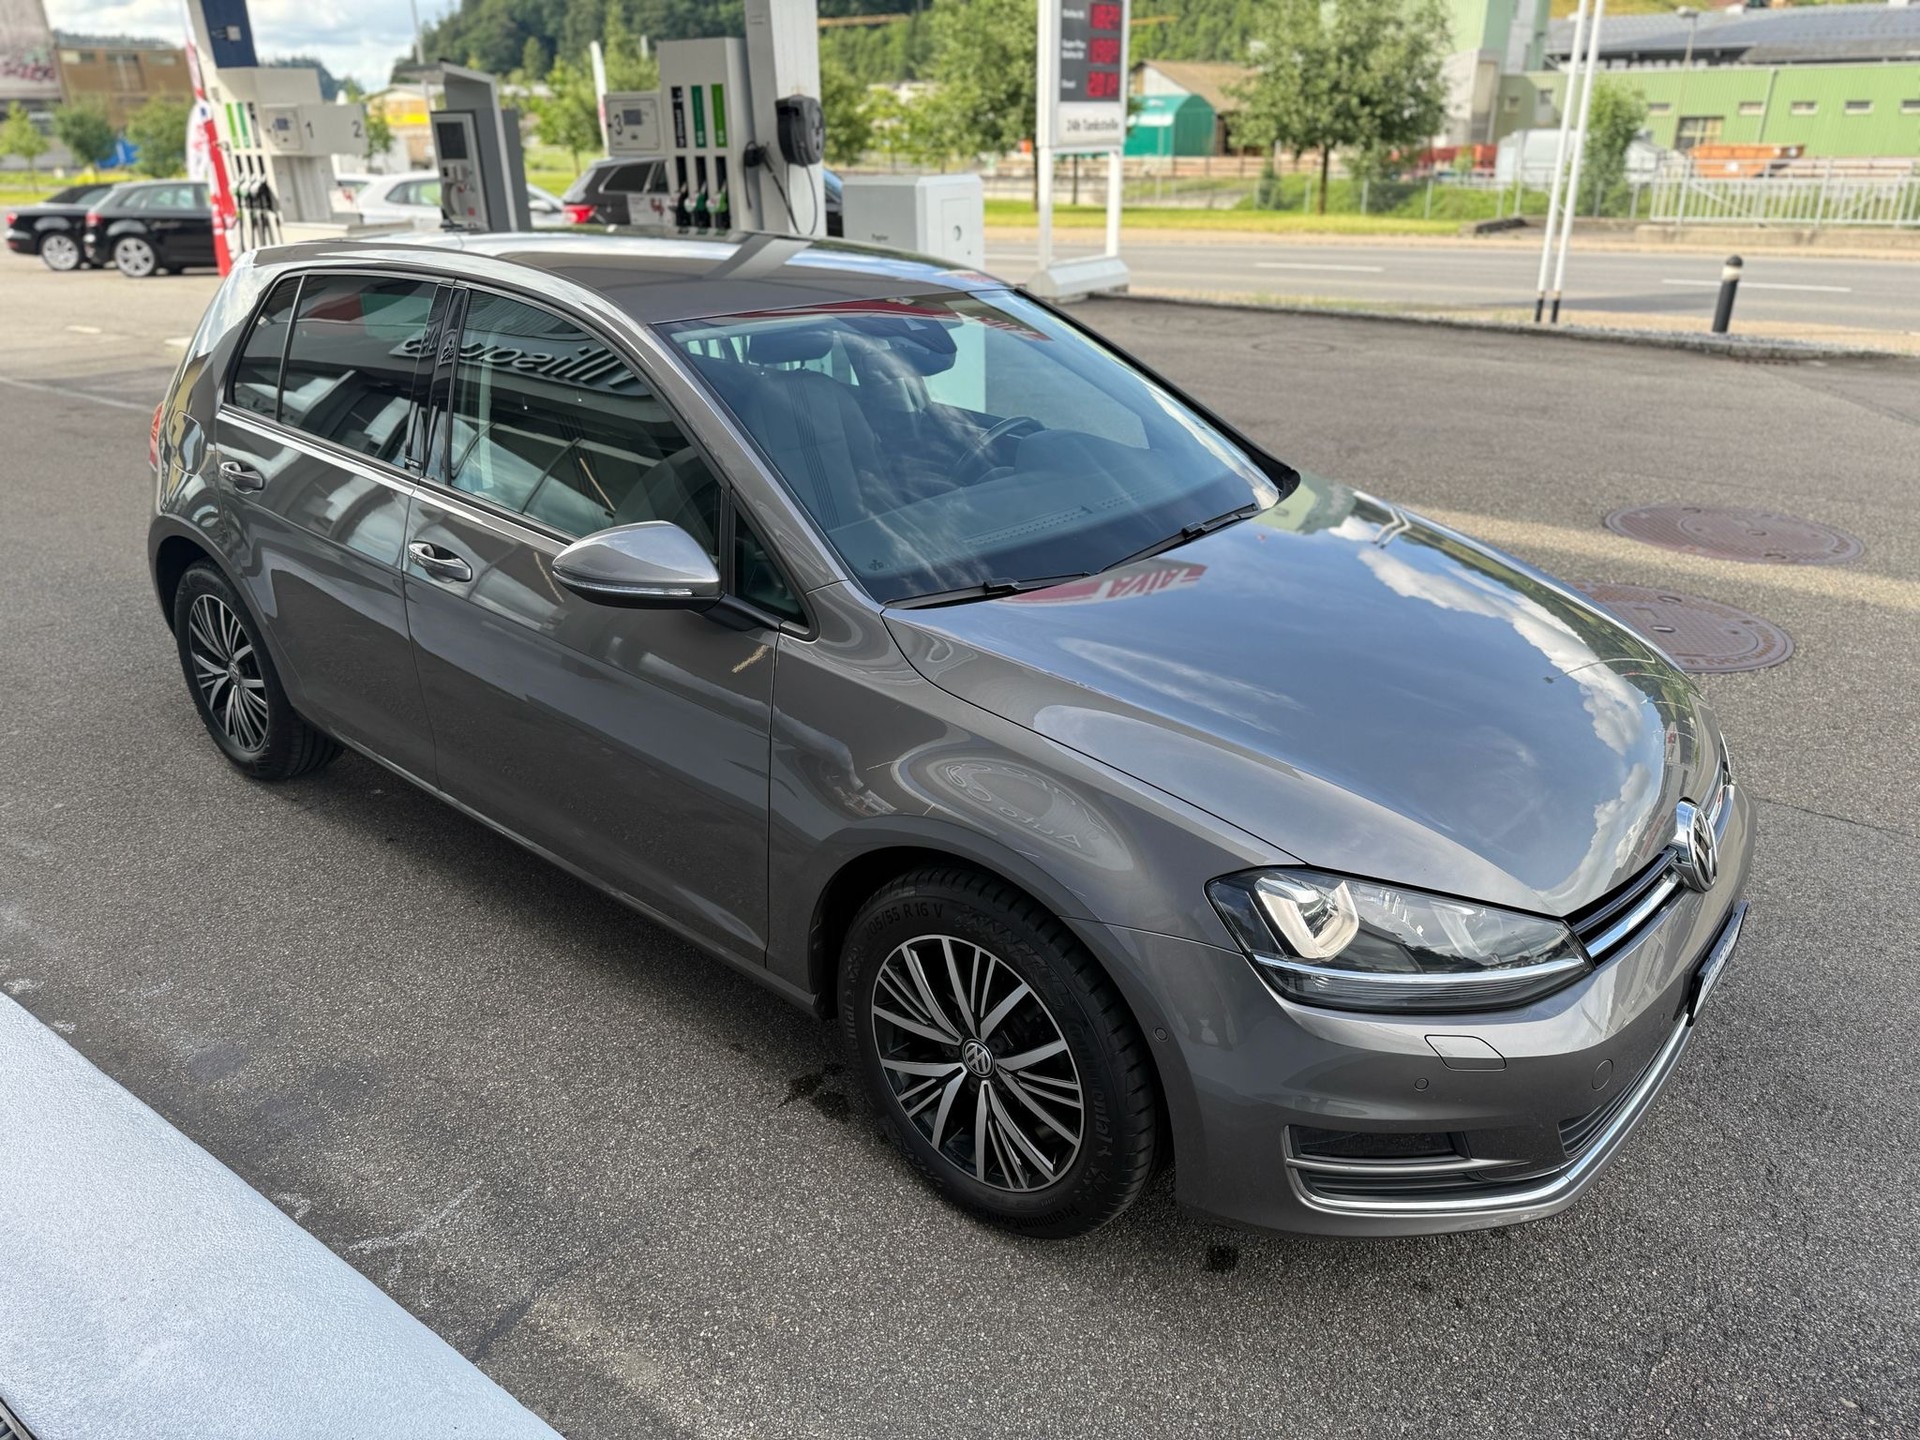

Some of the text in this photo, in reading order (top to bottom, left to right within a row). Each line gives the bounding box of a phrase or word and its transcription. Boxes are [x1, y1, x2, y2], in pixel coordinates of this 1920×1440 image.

[305, 121, 314, 139] 1
[351, 120, 362, 138] 2
[614, 113, 623, 136] 3
[915, 902, 929, 917] 16
